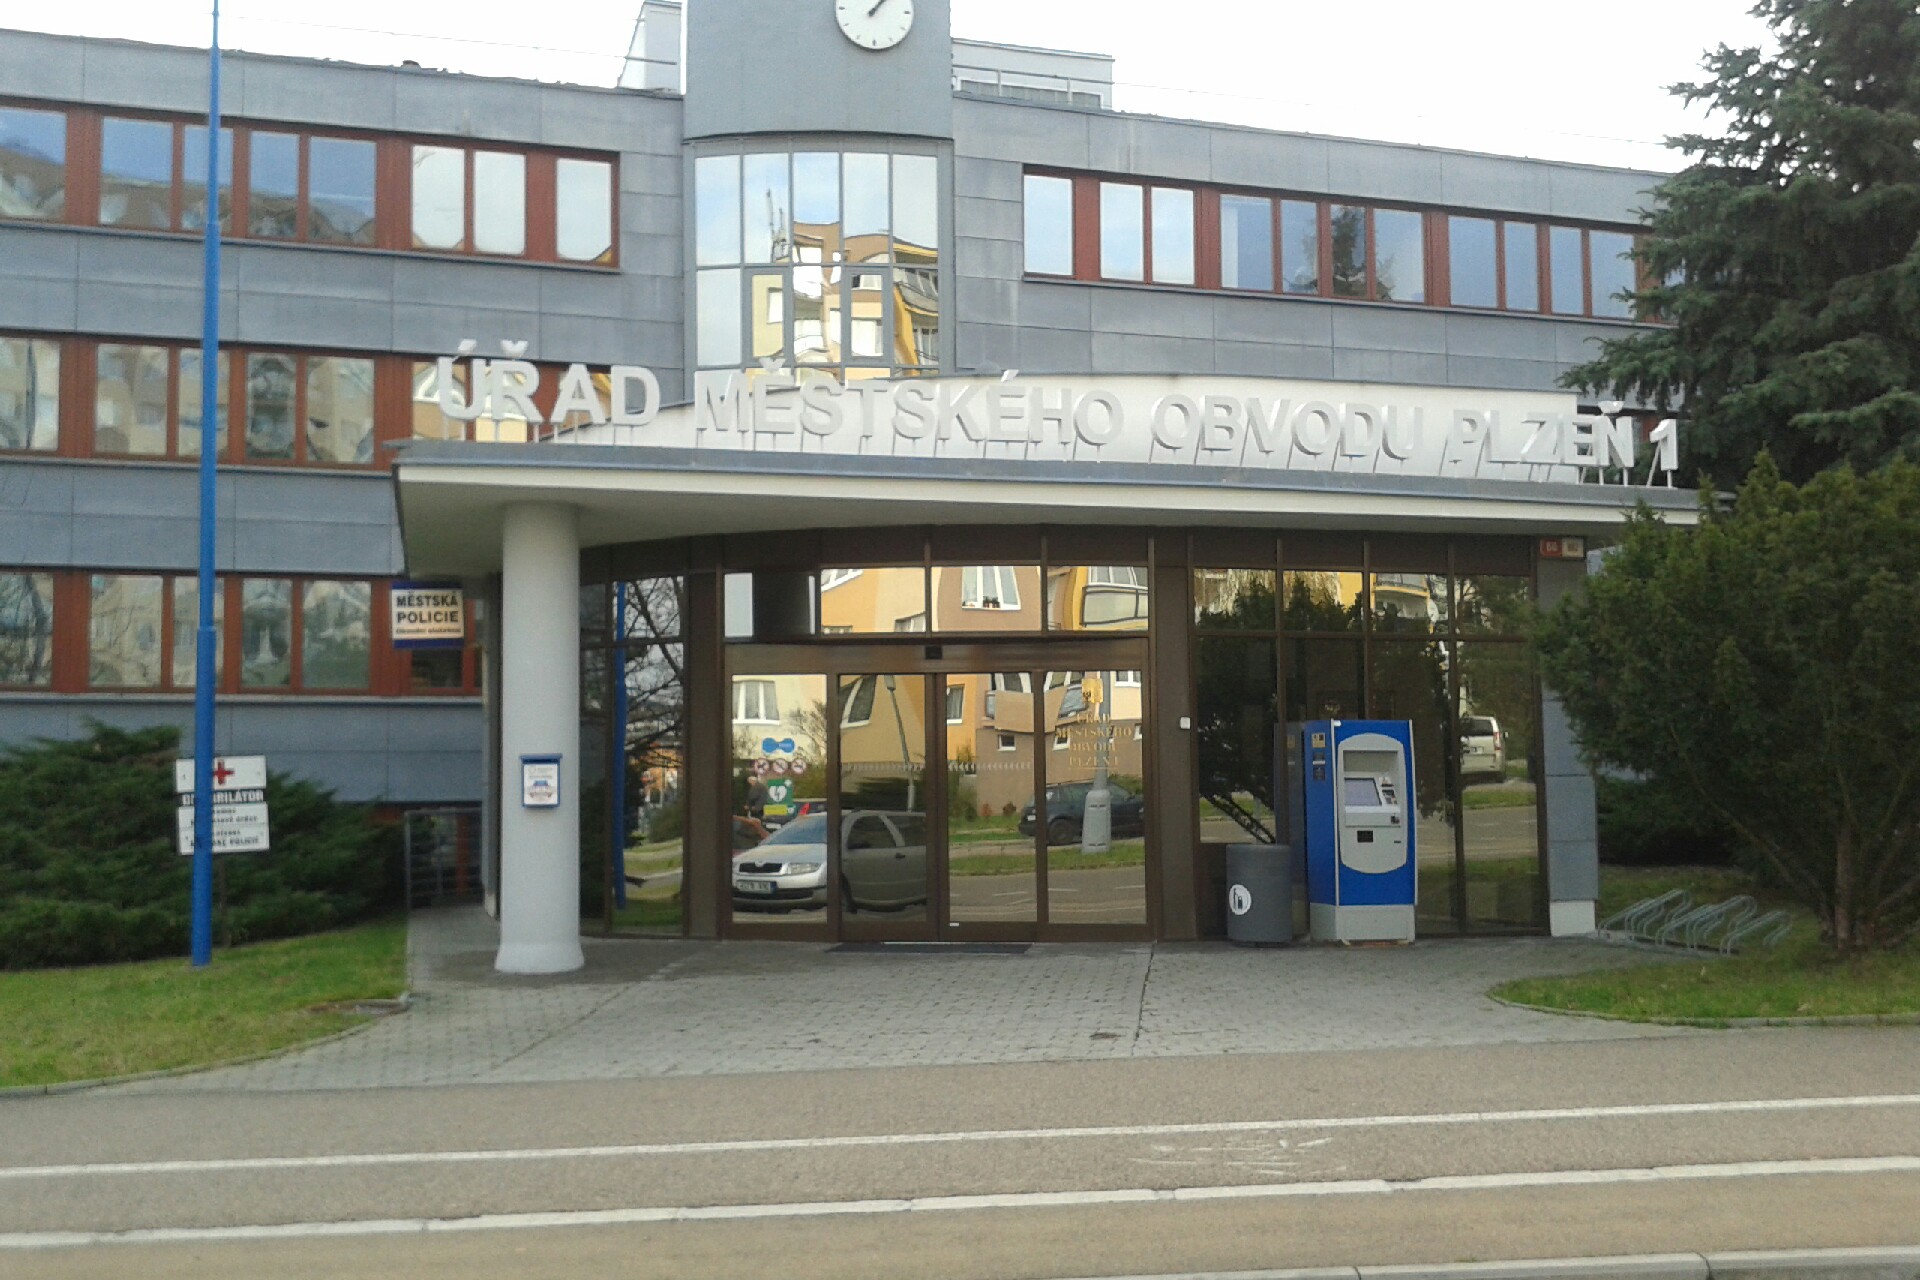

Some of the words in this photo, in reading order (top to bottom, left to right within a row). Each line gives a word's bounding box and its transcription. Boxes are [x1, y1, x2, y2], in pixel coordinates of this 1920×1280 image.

[437, 339, 660, 427] ÚŘAD
[694, 357, 1124, 447] MĚSTSKÉHO
[1150, 393, 1424, 460] OBVODU
[1451, 399, 1636, 469] PLZEŇ
[1649, 417, 1679, 471] 1
[397, 590, 459, 607] MĚSTSKÁ
[397, 610, 459, 623] POLICIE
